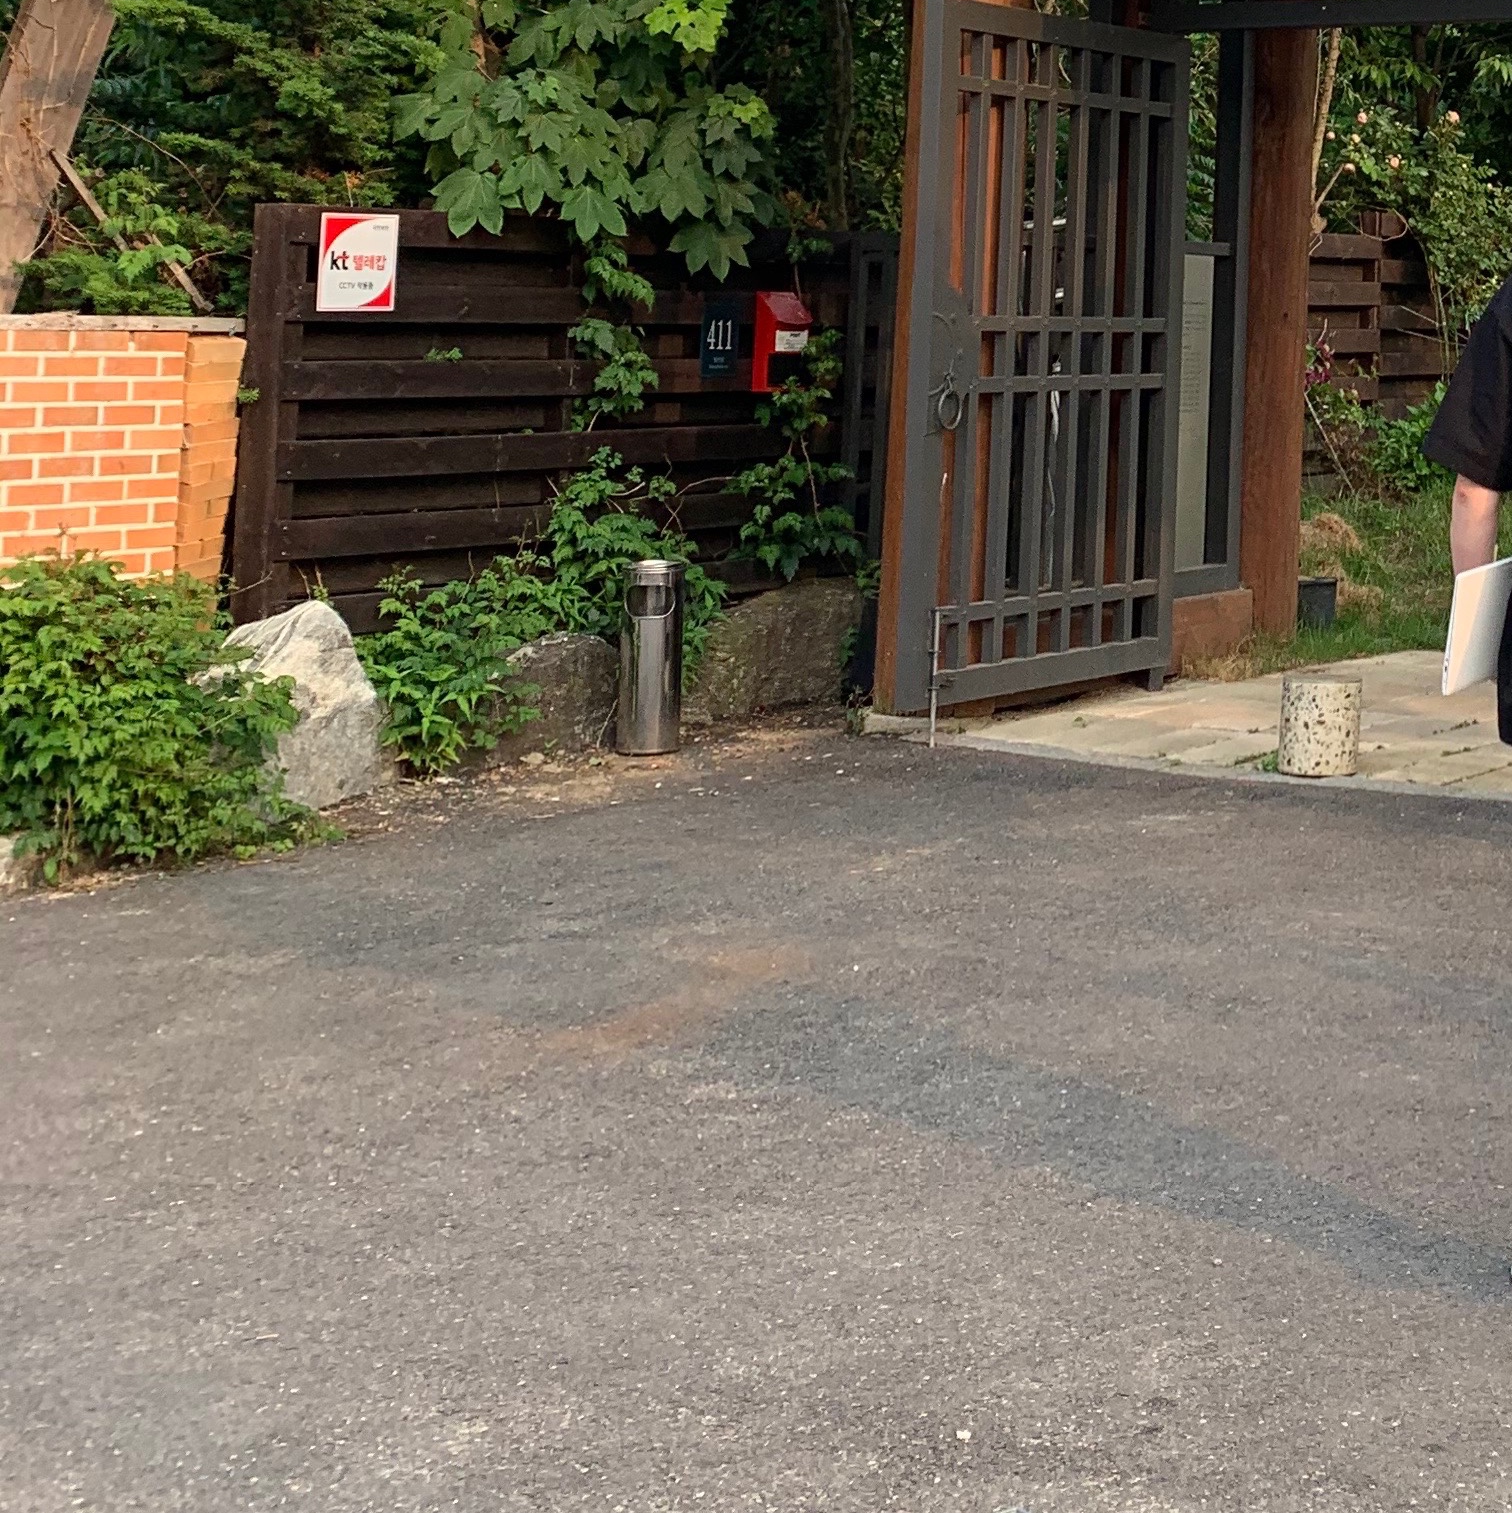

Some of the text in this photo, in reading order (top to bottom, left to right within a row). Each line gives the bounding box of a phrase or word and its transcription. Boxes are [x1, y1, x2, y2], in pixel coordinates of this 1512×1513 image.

[330, 251, 387, 271] kt 텔레캅
[338, 281, 356, 290] CCTV
[706, 319, 732, 350] 411
